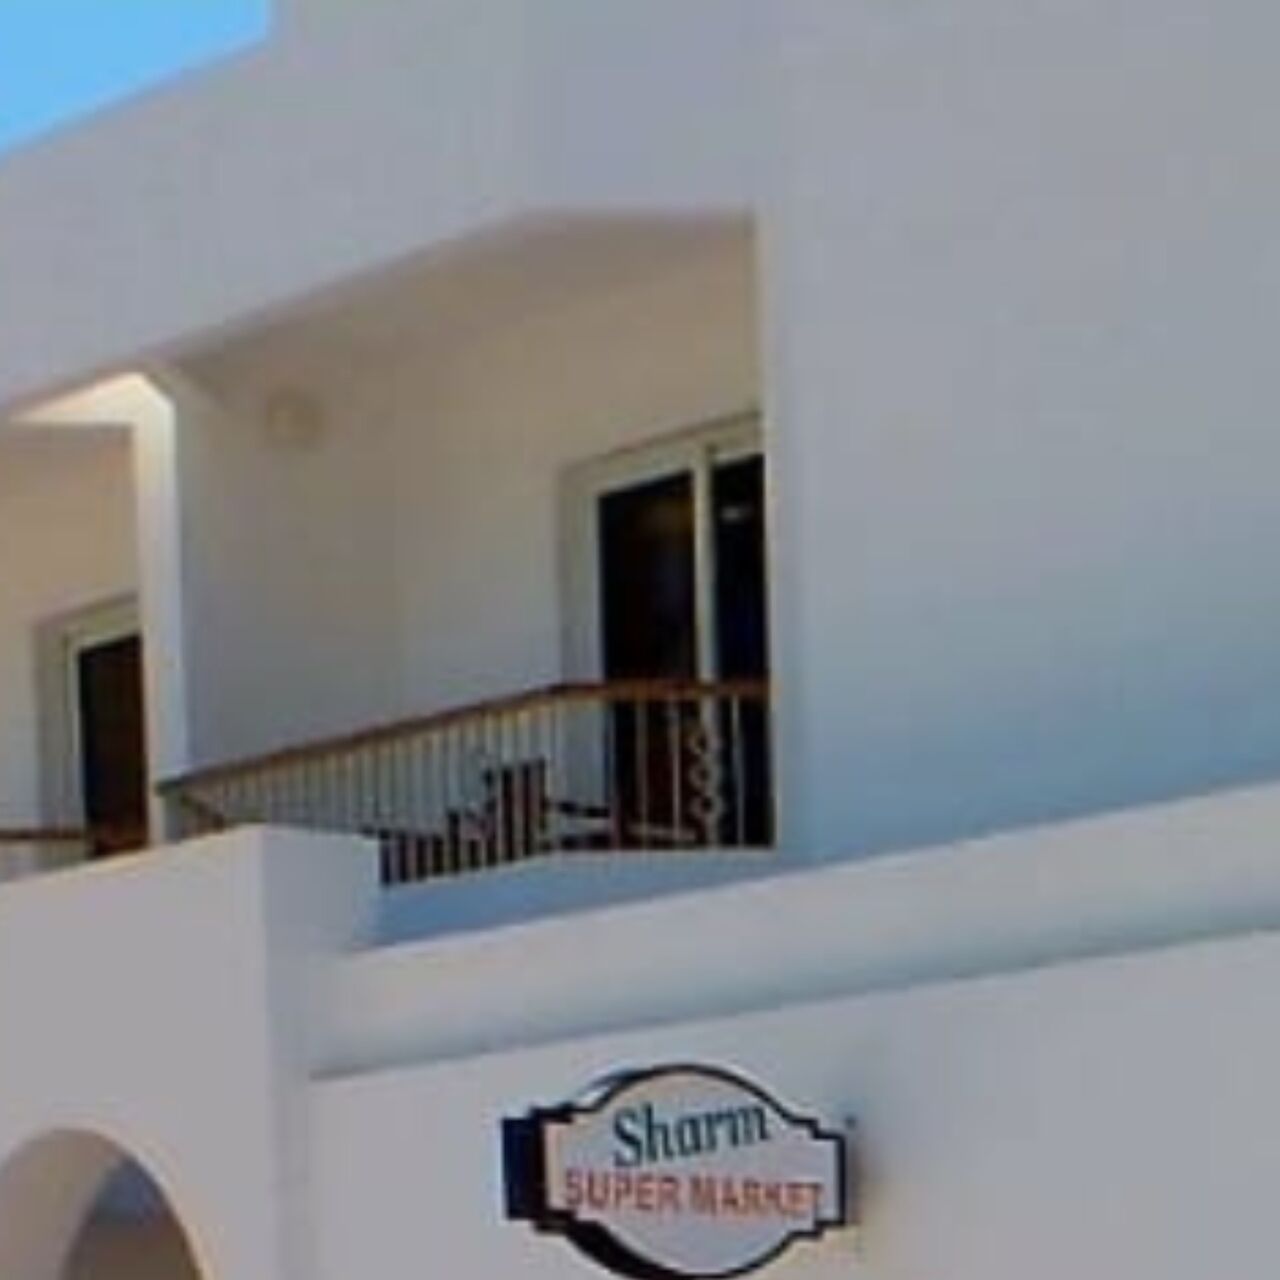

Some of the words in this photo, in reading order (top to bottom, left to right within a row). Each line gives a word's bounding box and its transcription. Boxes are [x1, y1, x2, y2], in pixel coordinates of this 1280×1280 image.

[613, 1103, 769, 1167] Sharm
[565, 1166, 680, 1213] SUPER
[690, 1173, 824, 1217] MARKET
